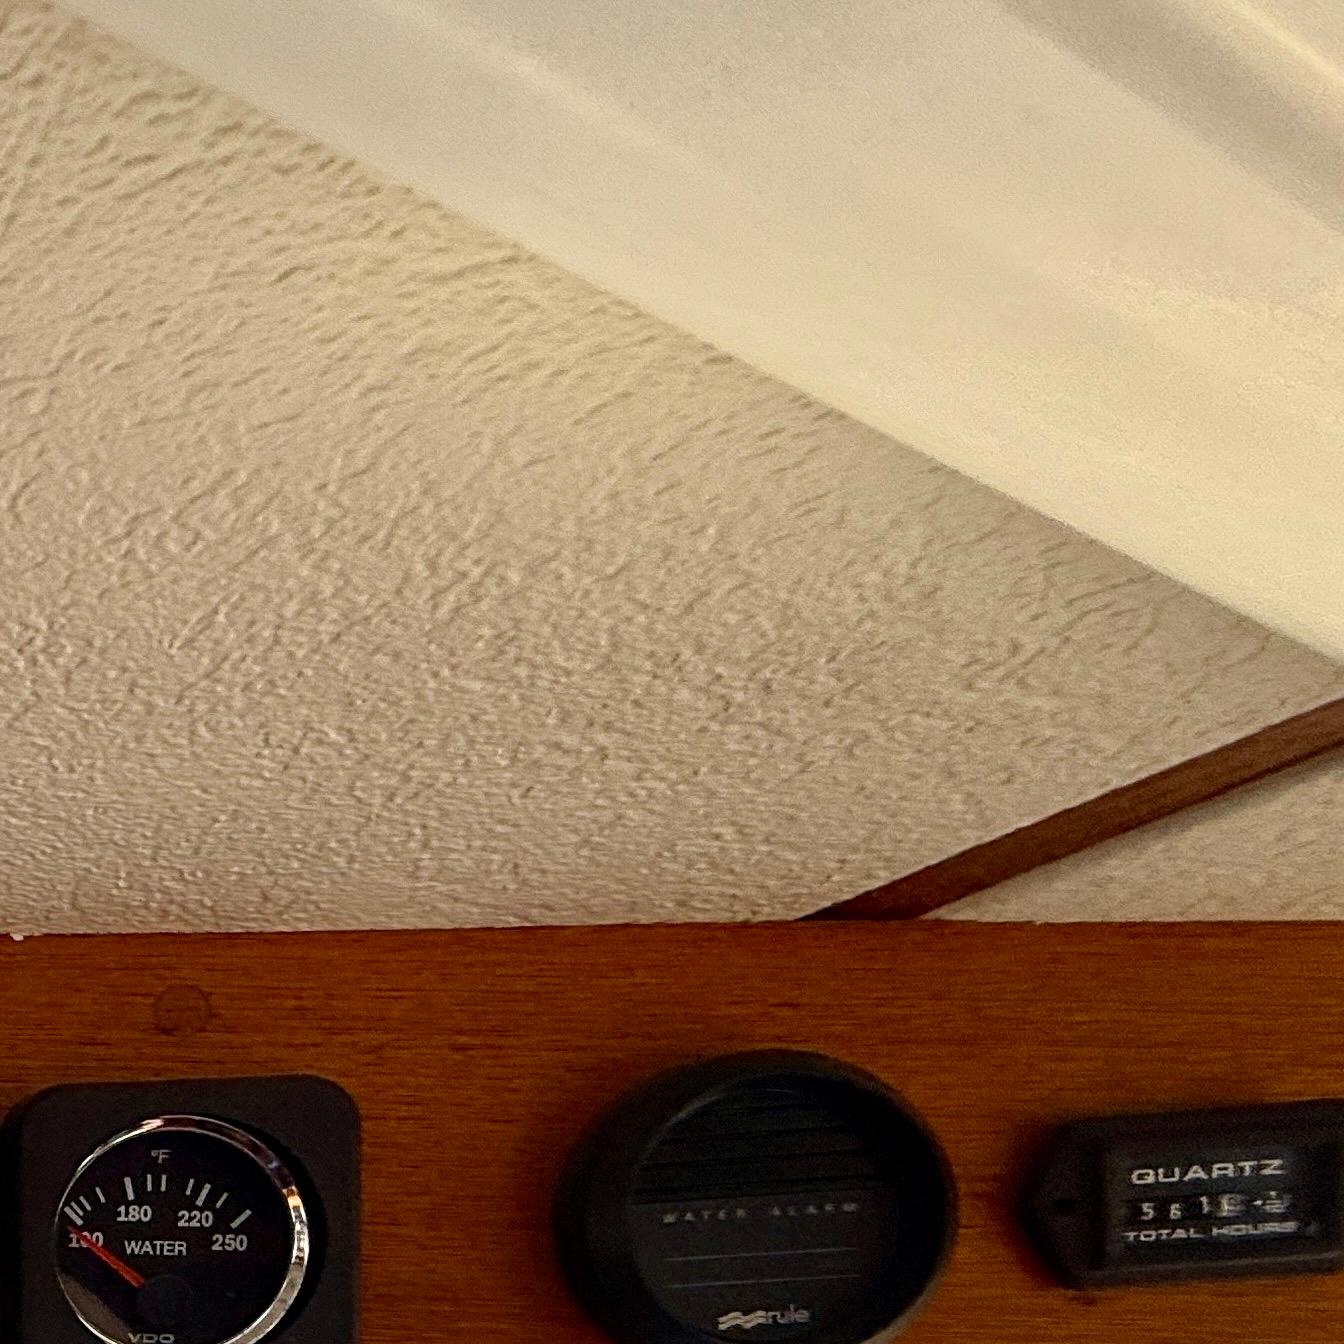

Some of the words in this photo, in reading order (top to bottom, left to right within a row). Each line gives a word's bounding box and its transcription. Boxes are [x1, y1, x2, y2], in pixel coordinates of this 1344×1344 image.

[1131, 1159, 1287, 1185] QUARTZ
[116, 1205, 152, 1222] 180
[177, 1210, 213, 1227] 220
[212, 1234, 248, 1251] 250
[1122, 1228, 1205, 1241] TOTAL
[124, 1240, 187, 1256] WATER
[128, 1332, 176, 1344] VDO
